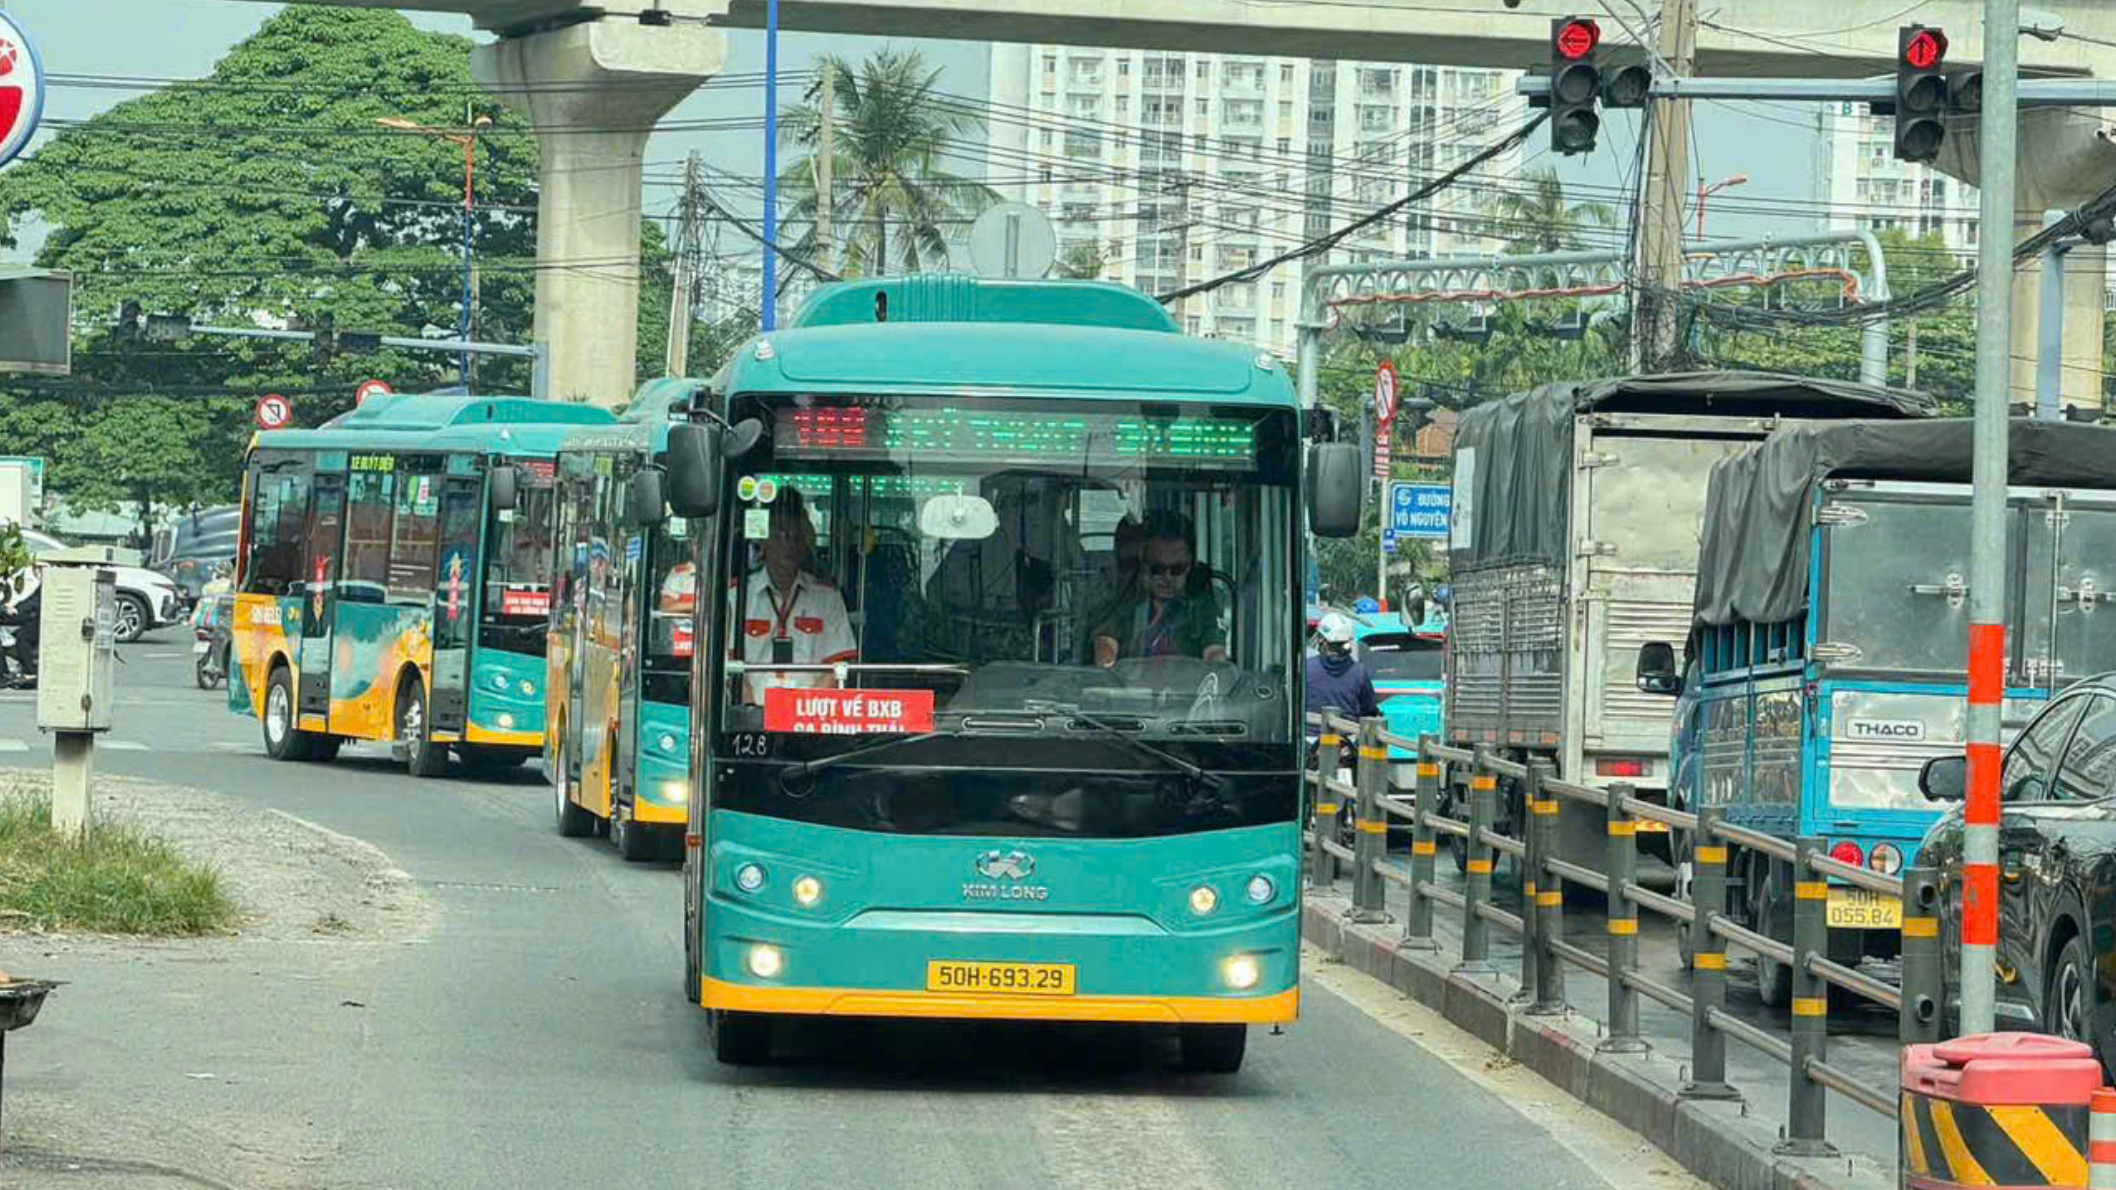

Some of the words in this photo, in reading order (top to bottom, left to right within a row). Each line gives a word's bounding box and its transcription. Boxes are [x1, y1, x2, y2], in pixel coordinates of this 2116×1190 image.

[796, 696, 838, 721] LƯỢT
[867, 701, 902, 719] BXB
[1854, 722, 1918, 737] THACO
[732, 734, 767, 756] 128
[963, 884, 997, 900] KIM
[1000, 885, 1048, 901] LONG
[1832, 907, 1893, 925] 055.84
[939, 966, 1063, 989] 50H-693.29
